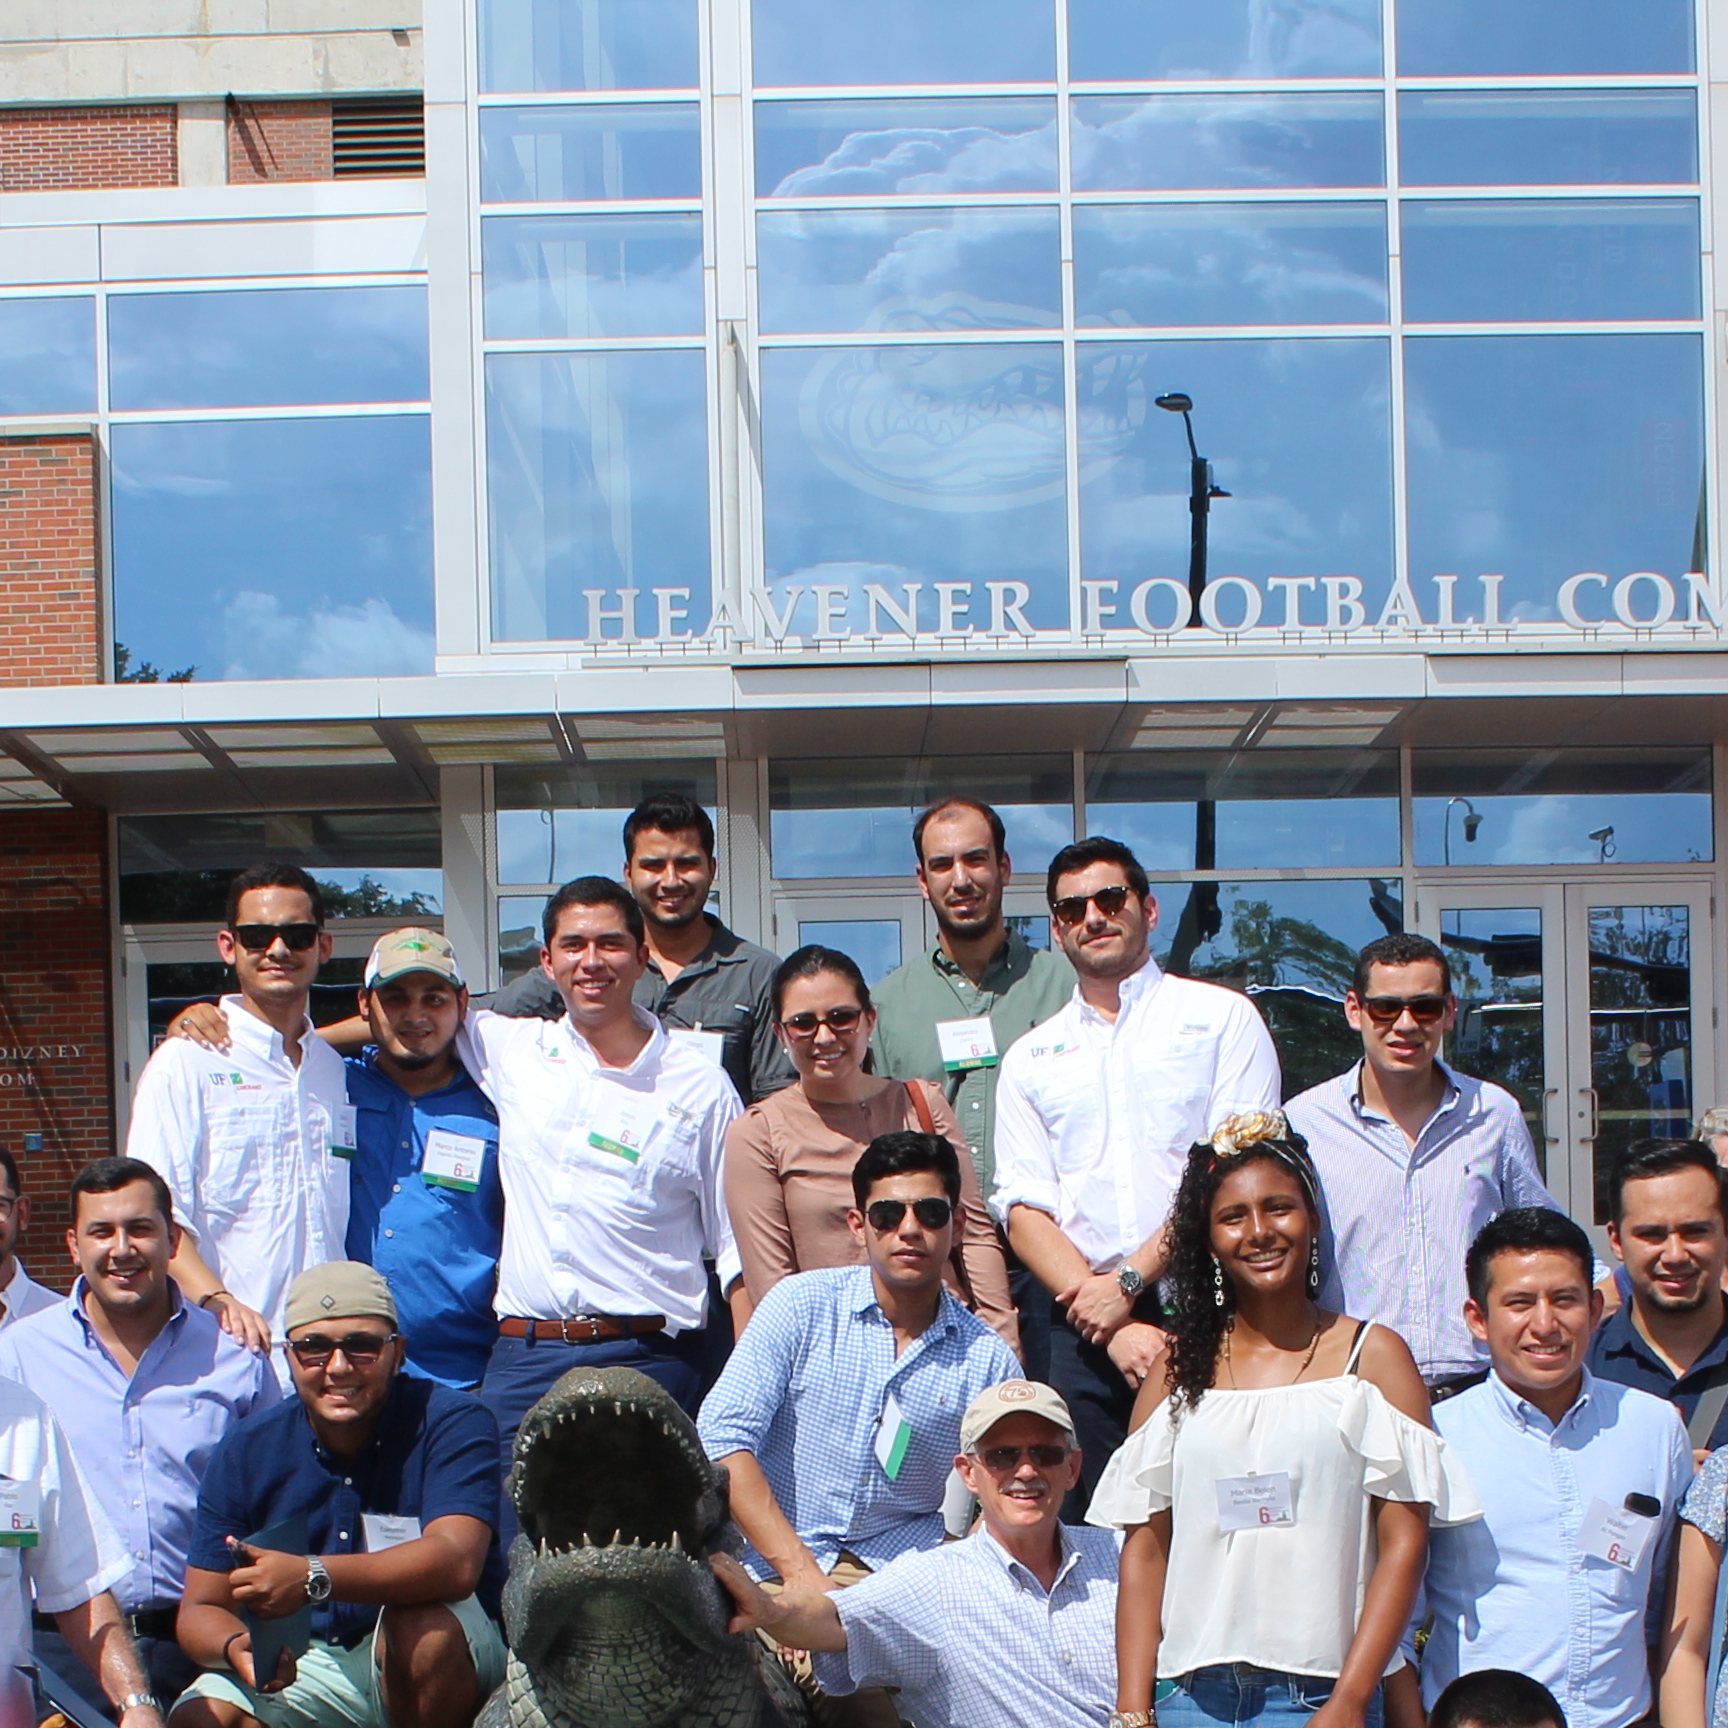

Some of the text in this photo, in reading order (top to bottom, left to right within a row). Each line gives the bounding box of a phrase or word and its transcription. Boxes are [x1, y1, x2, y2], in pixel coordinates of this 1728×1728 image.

[582, 581, 1036, 645] HEAVENER
[1080, 575, 1520, 637] FOOTBALL
[1031, 1047, 1050, 1058] UF
[209, 1073, 226, 1086] UF
